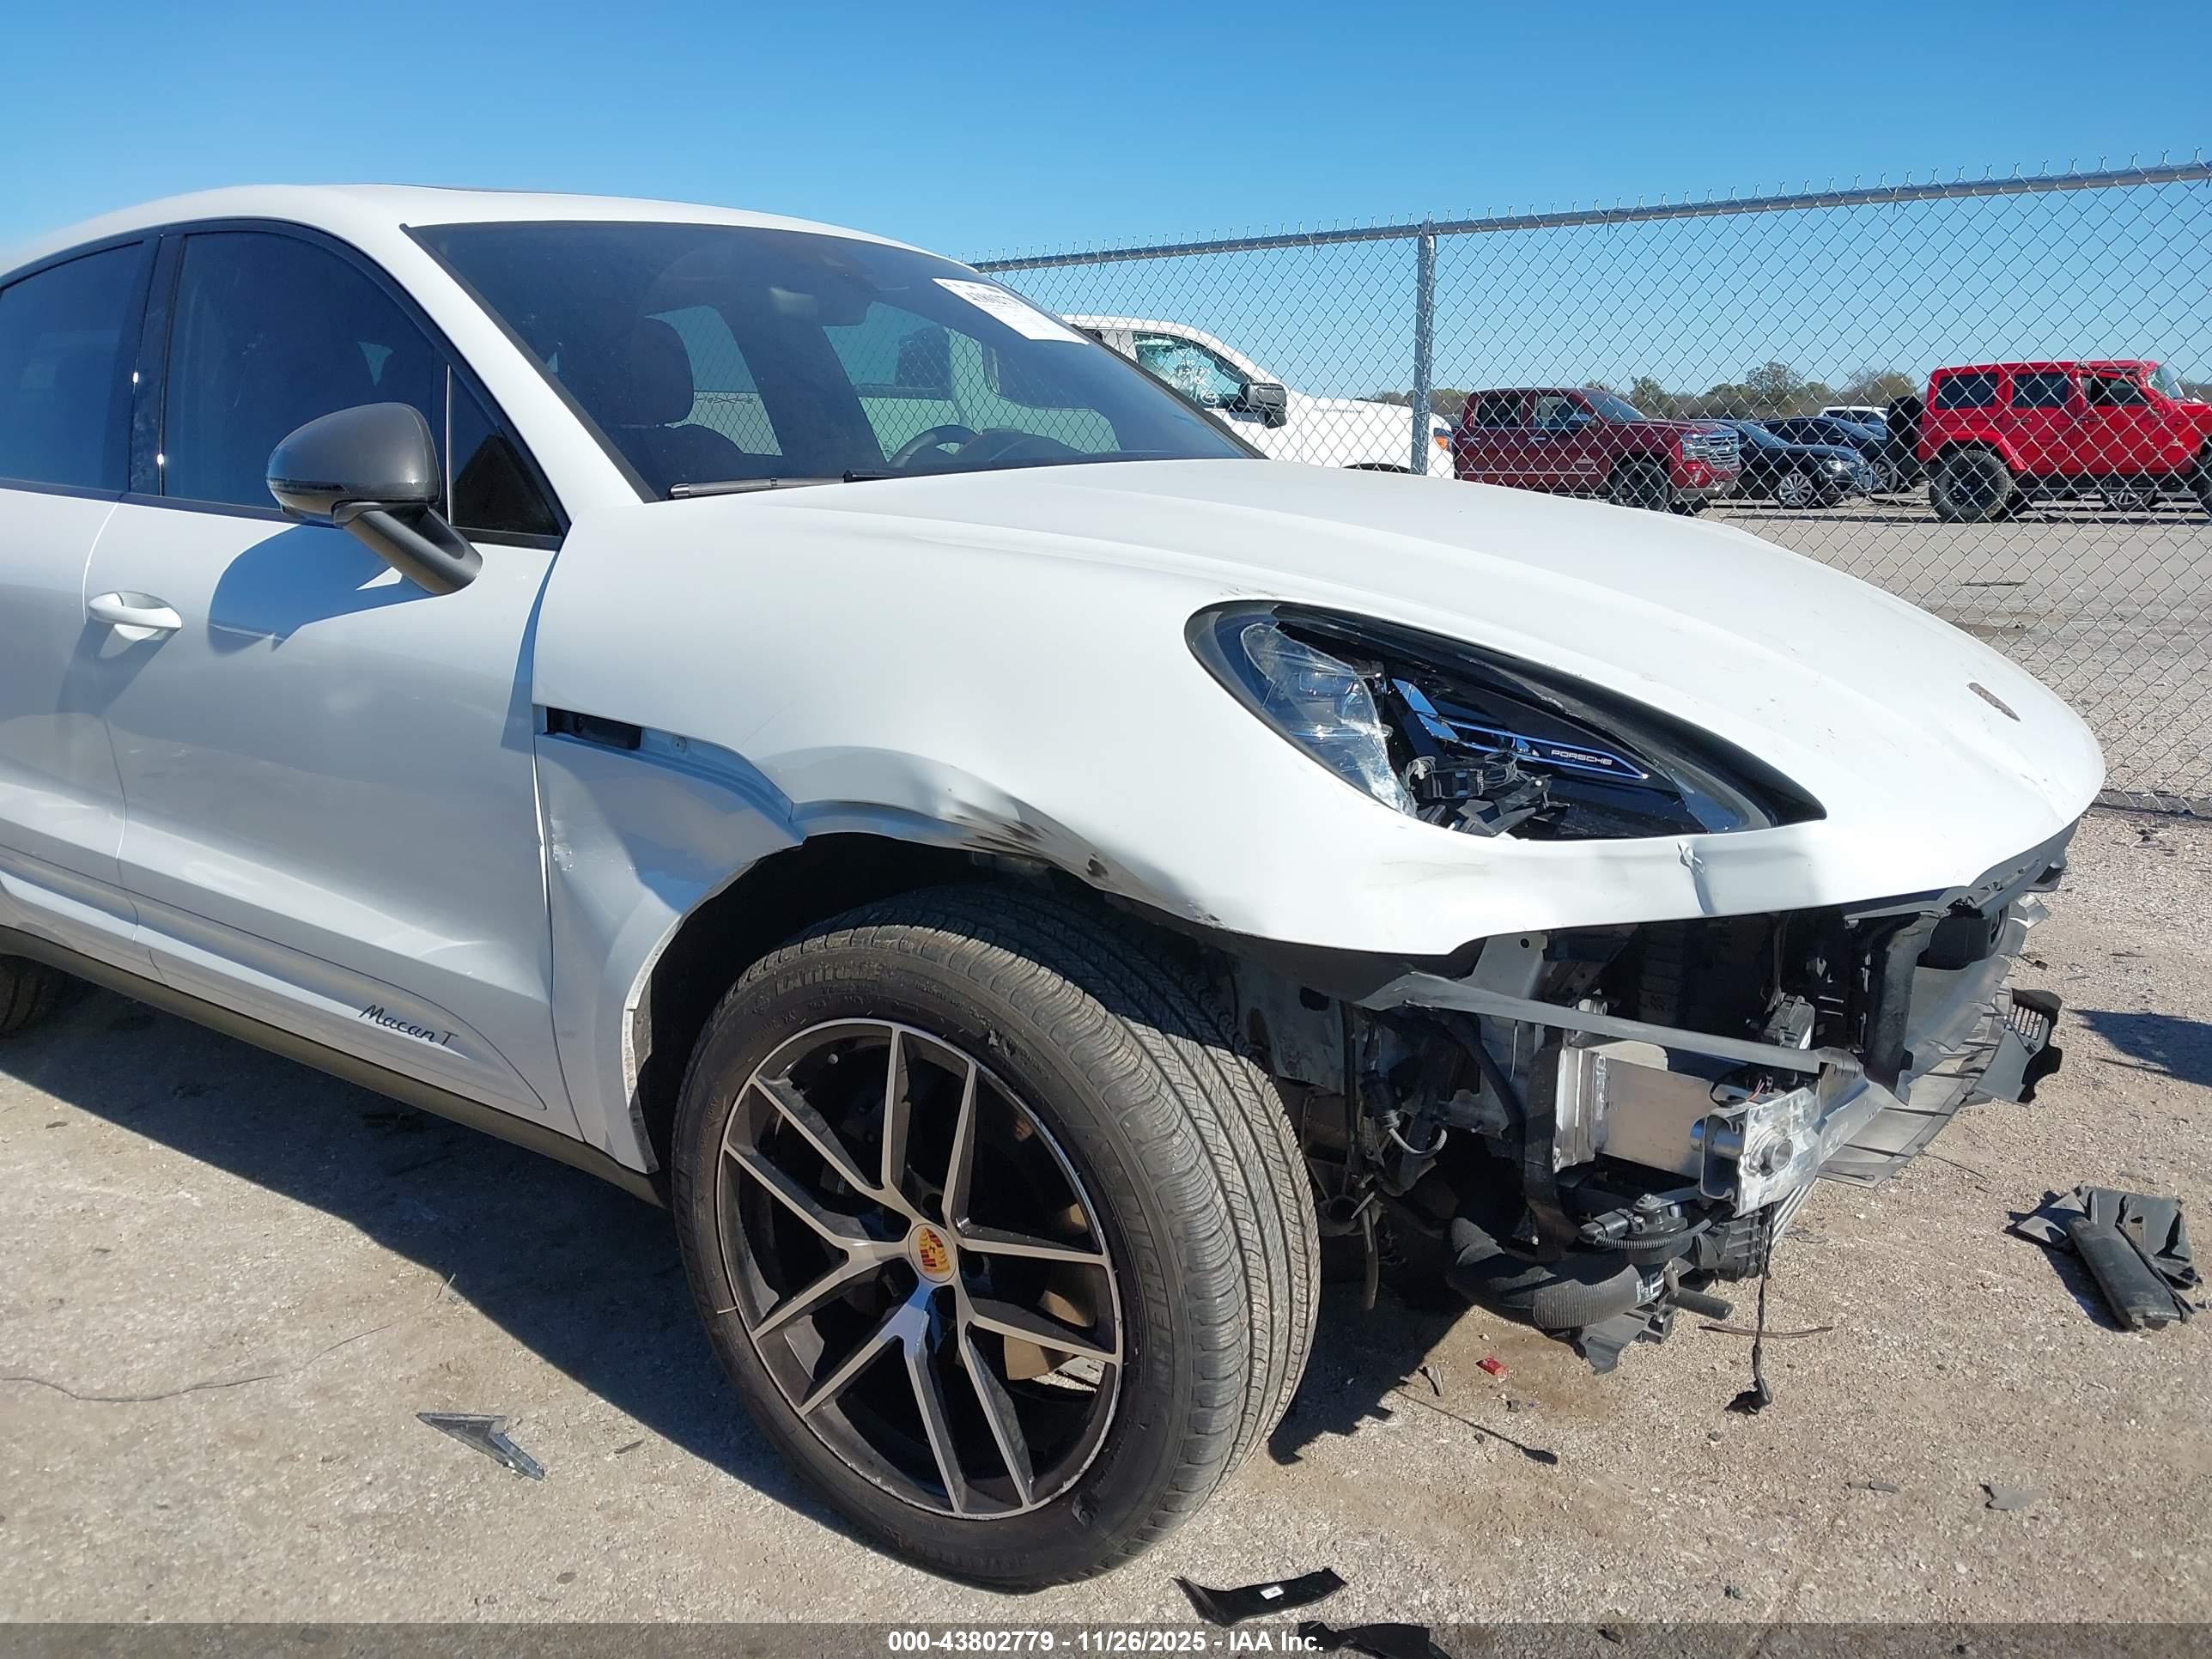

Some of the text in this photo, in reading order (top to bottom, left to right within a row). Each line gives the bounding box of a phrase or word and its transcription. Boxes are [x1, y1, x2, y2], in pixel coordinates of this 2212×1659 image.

[1551, 749, 1613, 766] PORSCHE
[359, 1004, 459, 1046] Macan T
